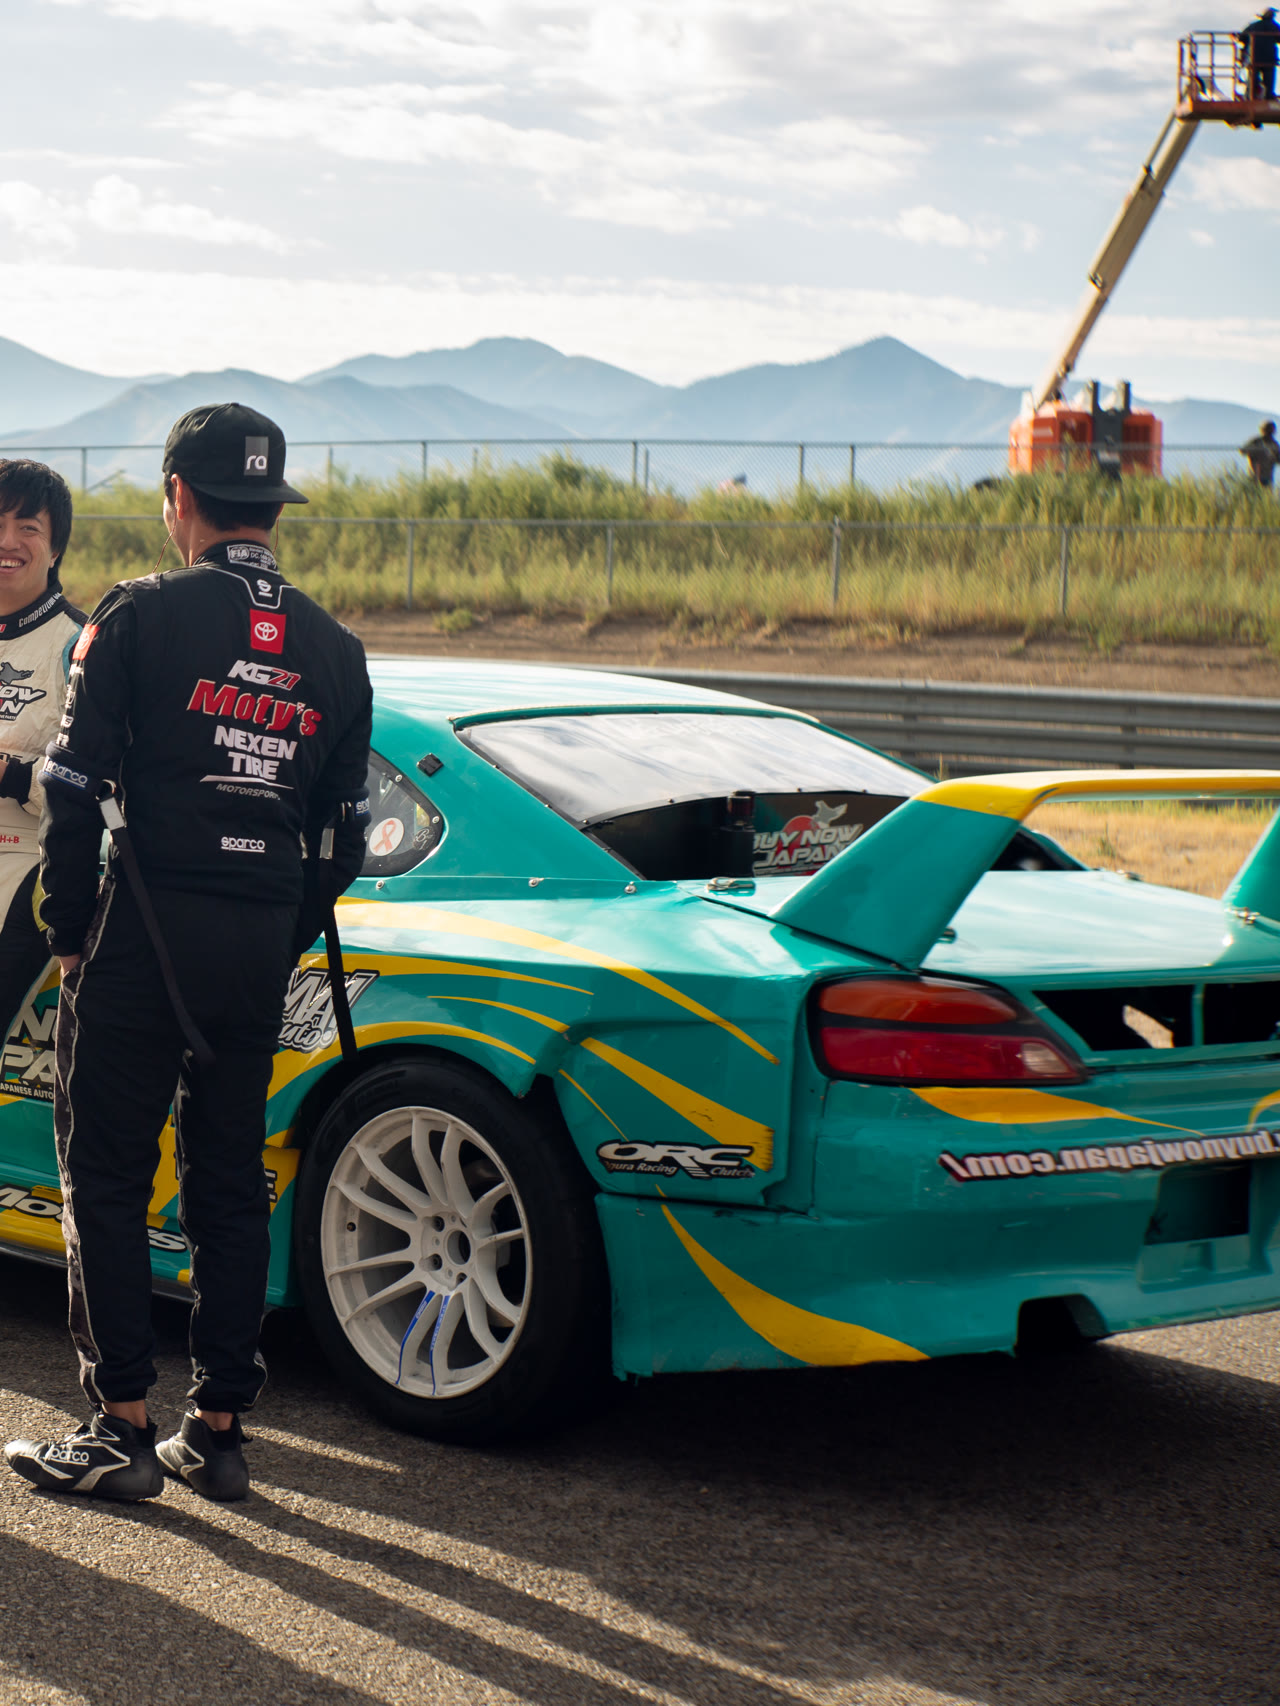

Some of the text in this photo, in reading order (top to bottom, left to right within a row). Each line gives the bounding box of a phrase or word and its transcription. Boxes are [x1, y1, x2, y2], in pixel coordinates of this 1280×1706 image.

[227, 660, 301, 691] KG21
[186, 679, 322, 736] Moty's
[214, 725, 298, 760] NEXEN
[228, 751, 280, 780] TIRE
[221, 836, 266, 852] sparco
[800, 824, 863, 846] NOW
[33, 1089, 55, 1100] AUTO
[598, 1143, 753, 1177] ORC
[637, 1162, 678, 1175] Racing
